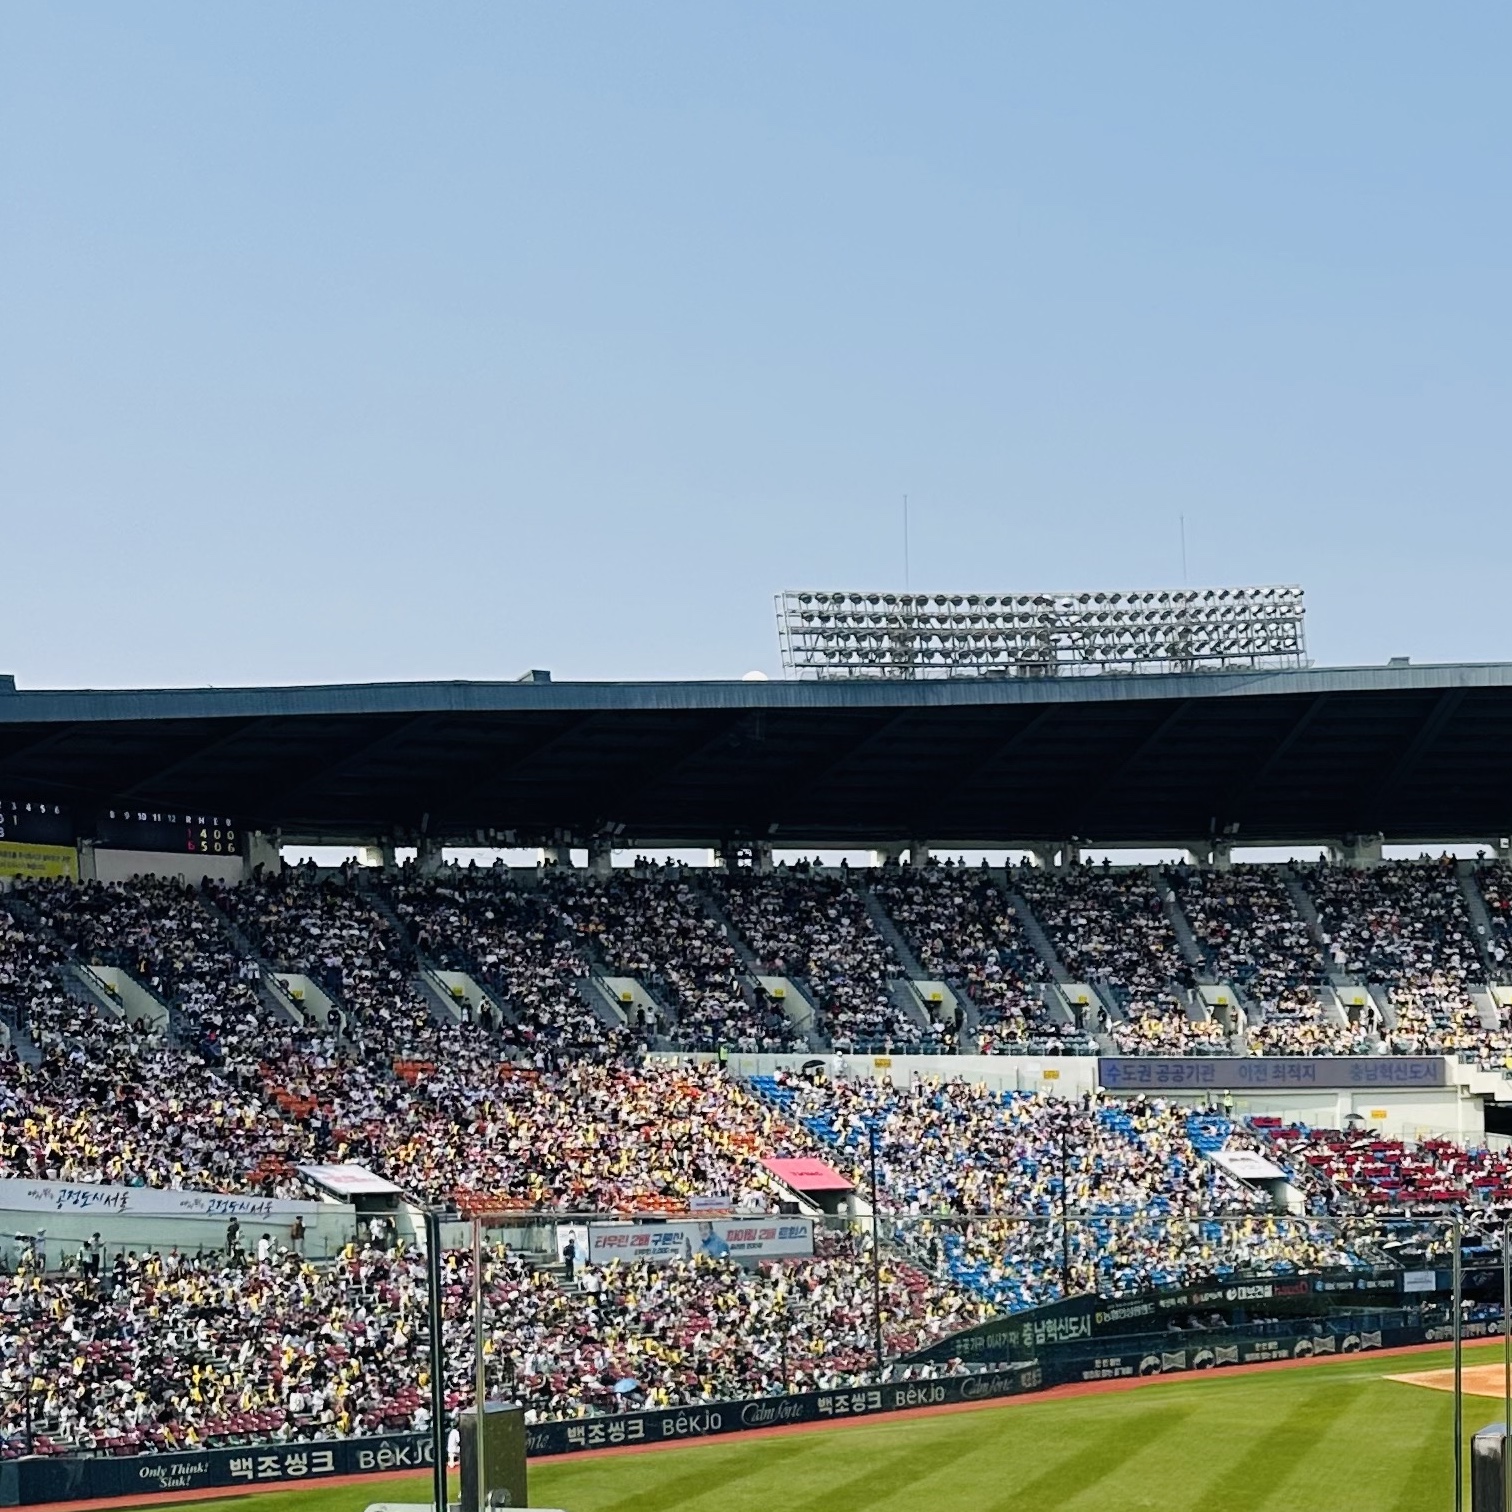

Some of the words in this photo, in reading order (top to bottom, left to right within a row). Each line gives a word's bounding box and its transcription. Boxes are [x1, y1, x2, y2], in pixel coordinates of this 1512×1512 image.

[200, 828, 208, 839] 4
[213, 829, 221, 840] 0
[201, 840, 208, 852] 5
[214, 842, 222, 852] 0
[1105, 1063, 1151, 1083] 수도권
[1156, 1063, 1216, 1083] 공공기관
[1272, 1063, 1317, 1083] 최적지
[1023, 1314, 1091, 1348] 충남혁신도시
[817, 1390, 882, 1415] 백조씽크
[567, 1419, 645, 1446] 백조씽크
[139, 1459, 168, 1478] Only
[170, 1454, 209, 1475] Think!
[229, 1450, 335, 1480] 백조씽크
[160, 1474, 191, 1488] Sink!
